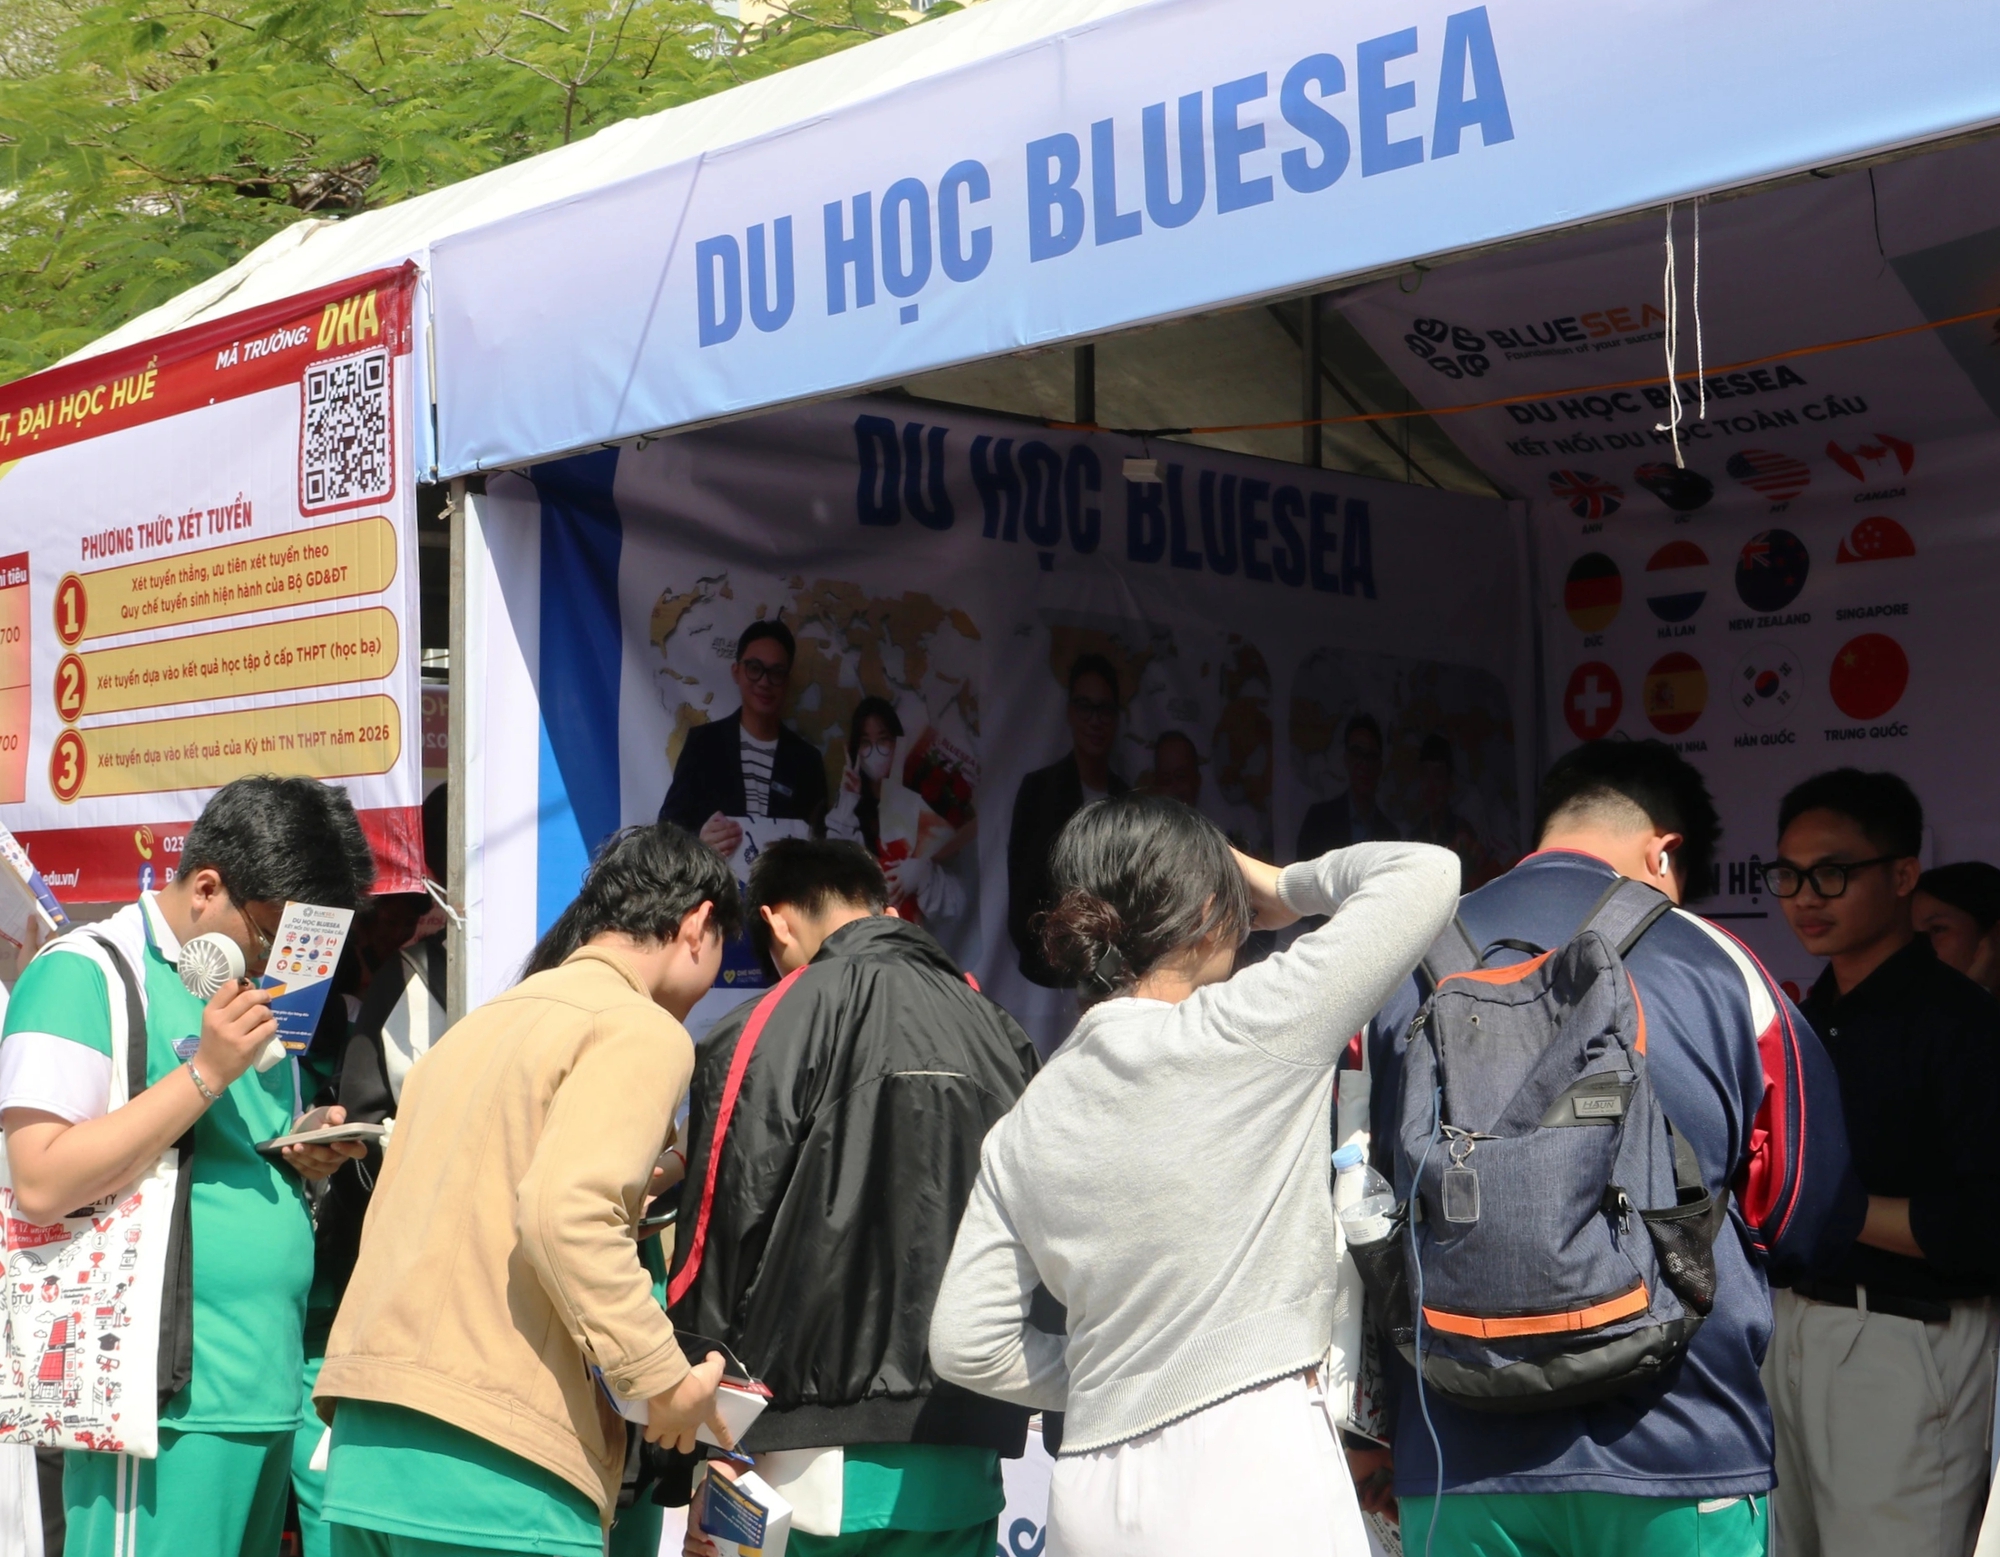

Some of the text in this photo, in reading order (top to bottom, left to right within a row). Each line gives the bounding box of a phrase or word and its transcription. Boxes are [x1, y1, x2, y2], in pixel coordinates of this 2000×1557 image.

[696, 5, 1515, 348] DU HỌC BLUESEA
[316, 289, 379, 351] DHA
[1486, 303, 1671, 349] BLUESEA
[215, 325, 311, 370] MÃ TRƯỜNG:
[1505, 347, 1573, 362] Foundation
[1576, 343, 1590, 353] of
[1592, 339, 1621, 352] your
[17, 400, 54, 440] ĐẠI
[58, 385, 107, 428] HỌC
[110, 355, 158, 410] HUẾ
[1505, 365, 1807, 425] DU HỌC BLUESEA
[1505, 394, 1868, 457] KẾT NỐI DU HỌC TOÀN CẦU
[854, 414, 1378, 600] DU HỌC BLUESEA
[1853, 487, 1906, 503] CANADA
[82, 491, 252, 561] PHƯƠNG THỨC XÉT TUYỂN
[7, 567, 27, 585] tiêu
[131, 544, 329, 592] Xét tuyển thẳng, ưu tiên xét tuyển theo
[63, 587, 79, 634] 1
[121, 566, 348, 619] Quy chế tuyển sinh hiện hành của Bộ GD&ĐT
[1836, 603, 1909, 621] SINGAPORE
[1657, 625, 1695, 639] HÀ LAN
[1729, 613, 1811, 631] NEW ZEALAND
[62, 663, 80, 710] 2
[97, 675, 112, 690] Xét
[115, 668, 140, 689] tuyển
[143, 669, 160, 687] dựa
[162, 665, 179, 680] vào
[182, 660, 198, 678] kết
[200, 658, 219, 678] quả
[222, 657, 240, 676] học
[243, 653, 260, 673] tập
[274, 647, 293, 666] cấp
[296, 644, 327, 662] THPT
[330, 642, 356, 660] (học
[360, 637, 381, 657] bạ)
[98, 725, 390, 768] Xét tuyển dựa vào kết quả của Kỳ thi TN THPT năm 2026
[1685, 741, 1708, 752] NHA
[1734, 729, 1795, 747] HÀN QUỐC
[1824, 721, 1908, 741] TRUNG QUỐC
[58, 741, 78, 790] 3
[1729, 854, 1762, 904] HỆ
